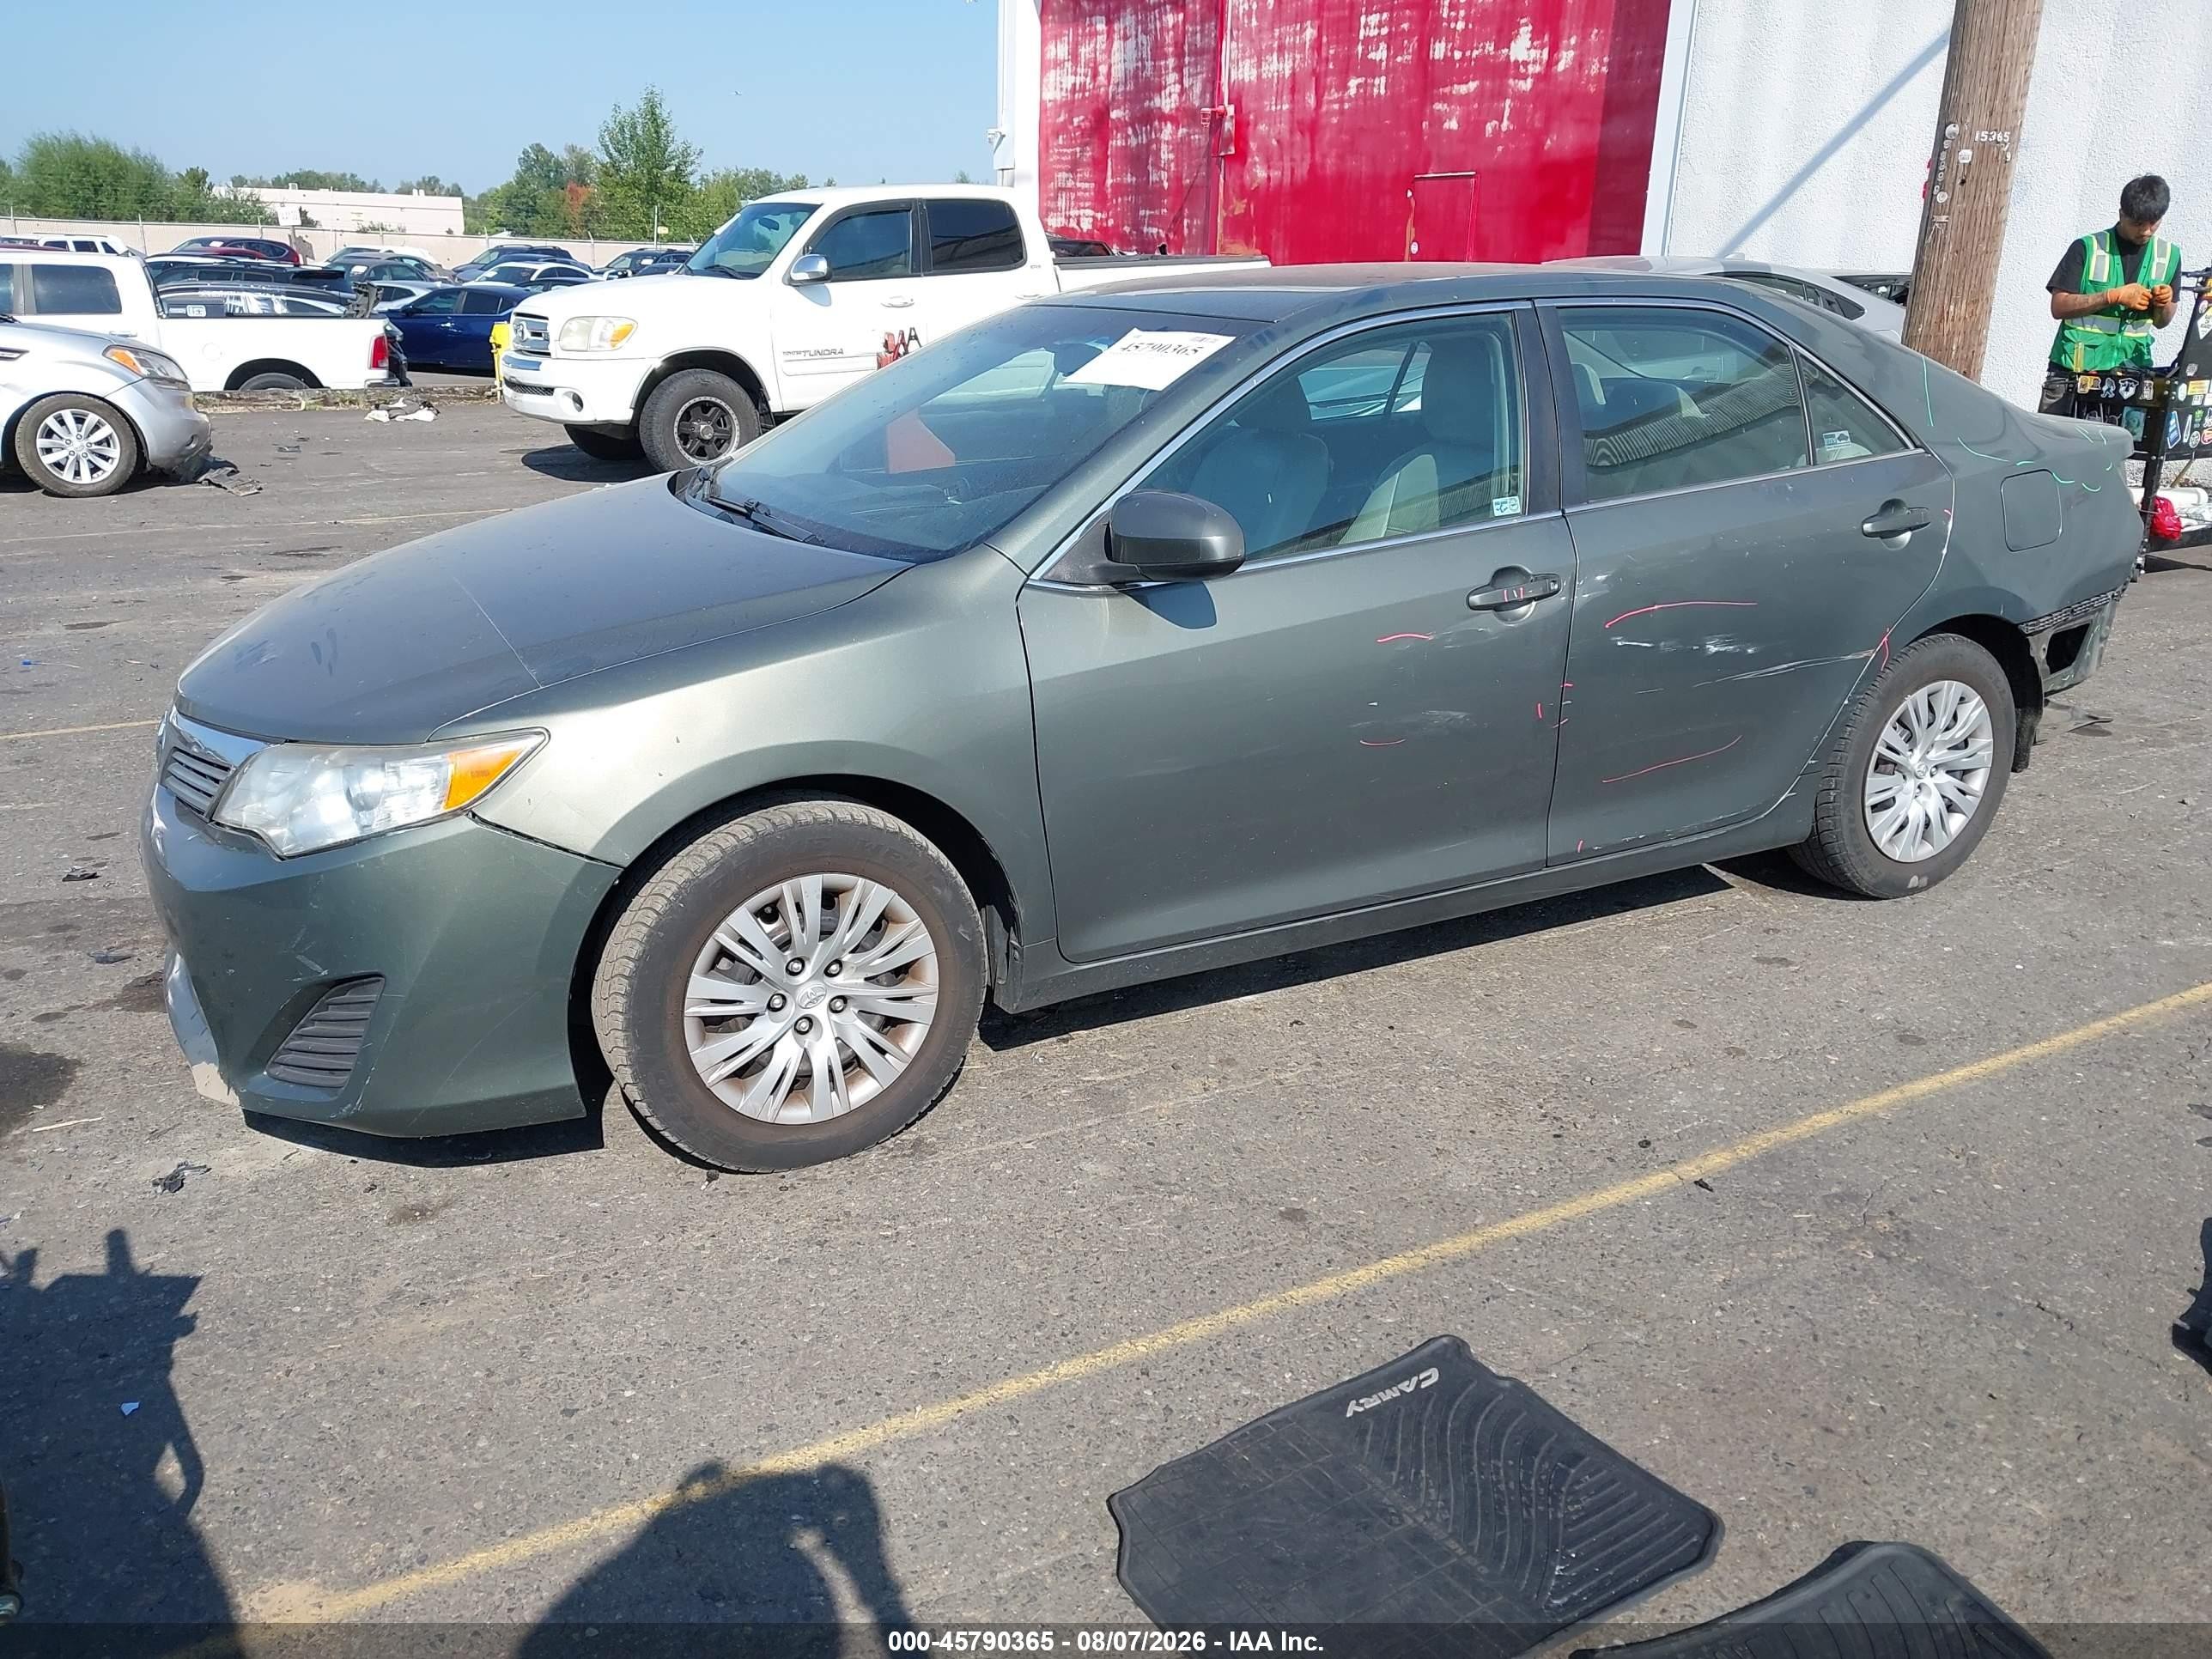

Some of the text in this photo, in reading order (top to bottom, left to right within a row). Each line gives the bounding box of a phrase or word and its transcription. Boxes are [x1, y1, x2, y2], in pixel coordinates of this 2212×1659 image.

[1974, 131, 2010, 143] 15365
[802, 348, 844, 357] TUNDRA
[1346, 1367, 1439, 1418] CAMRY
